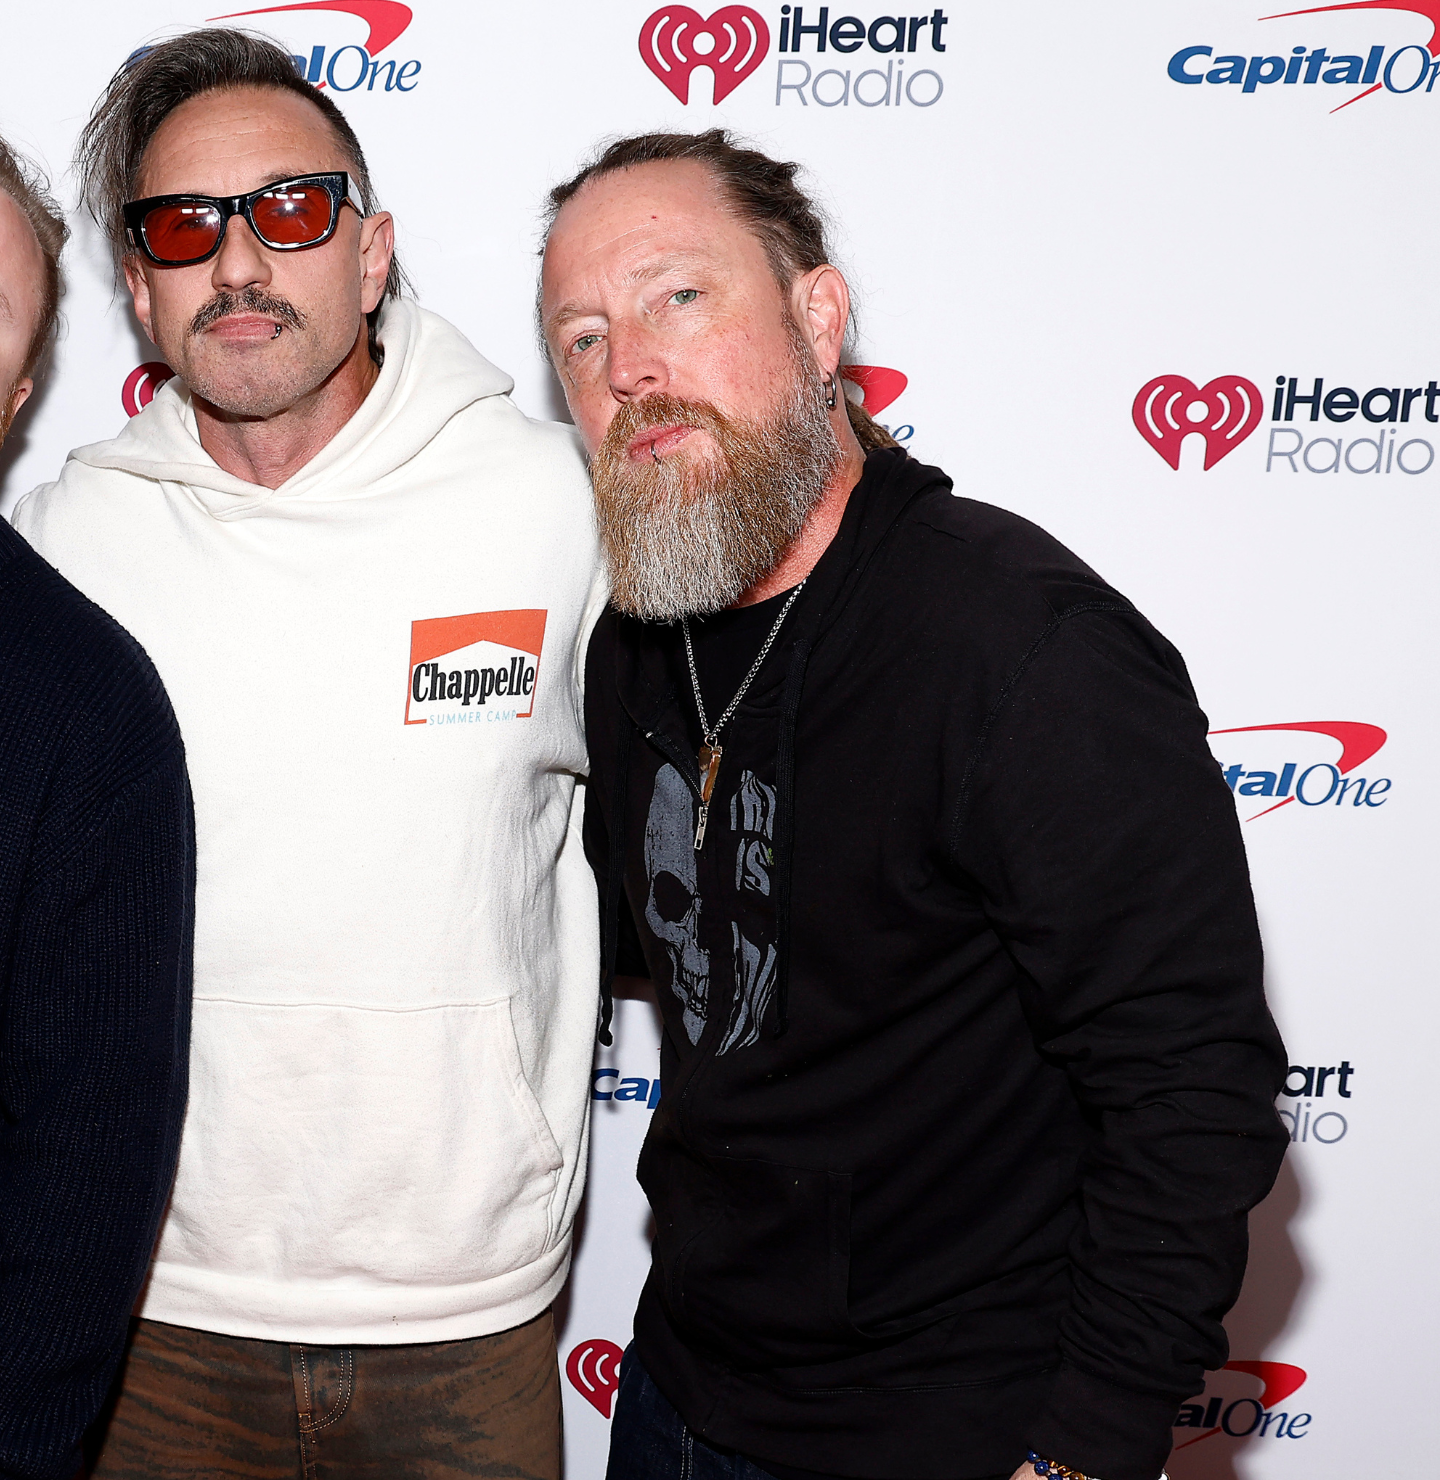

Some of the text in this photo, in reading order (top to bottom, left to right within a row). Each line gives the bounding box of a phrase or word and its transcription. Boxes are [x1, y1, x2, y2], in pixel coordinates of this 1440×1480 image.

[778, 4, 949, 54] iHeart
[775, 58, 944, 107] Radio
[1167, 45, 1440, 93] CapitalO
[1271, 375, 1440, 423] iHeart
[1266, 428, 1435, 475] Radio
[412, 656, 535, 706] Chappelle
[429, 710, 517, 726] SUMMER CAMP
